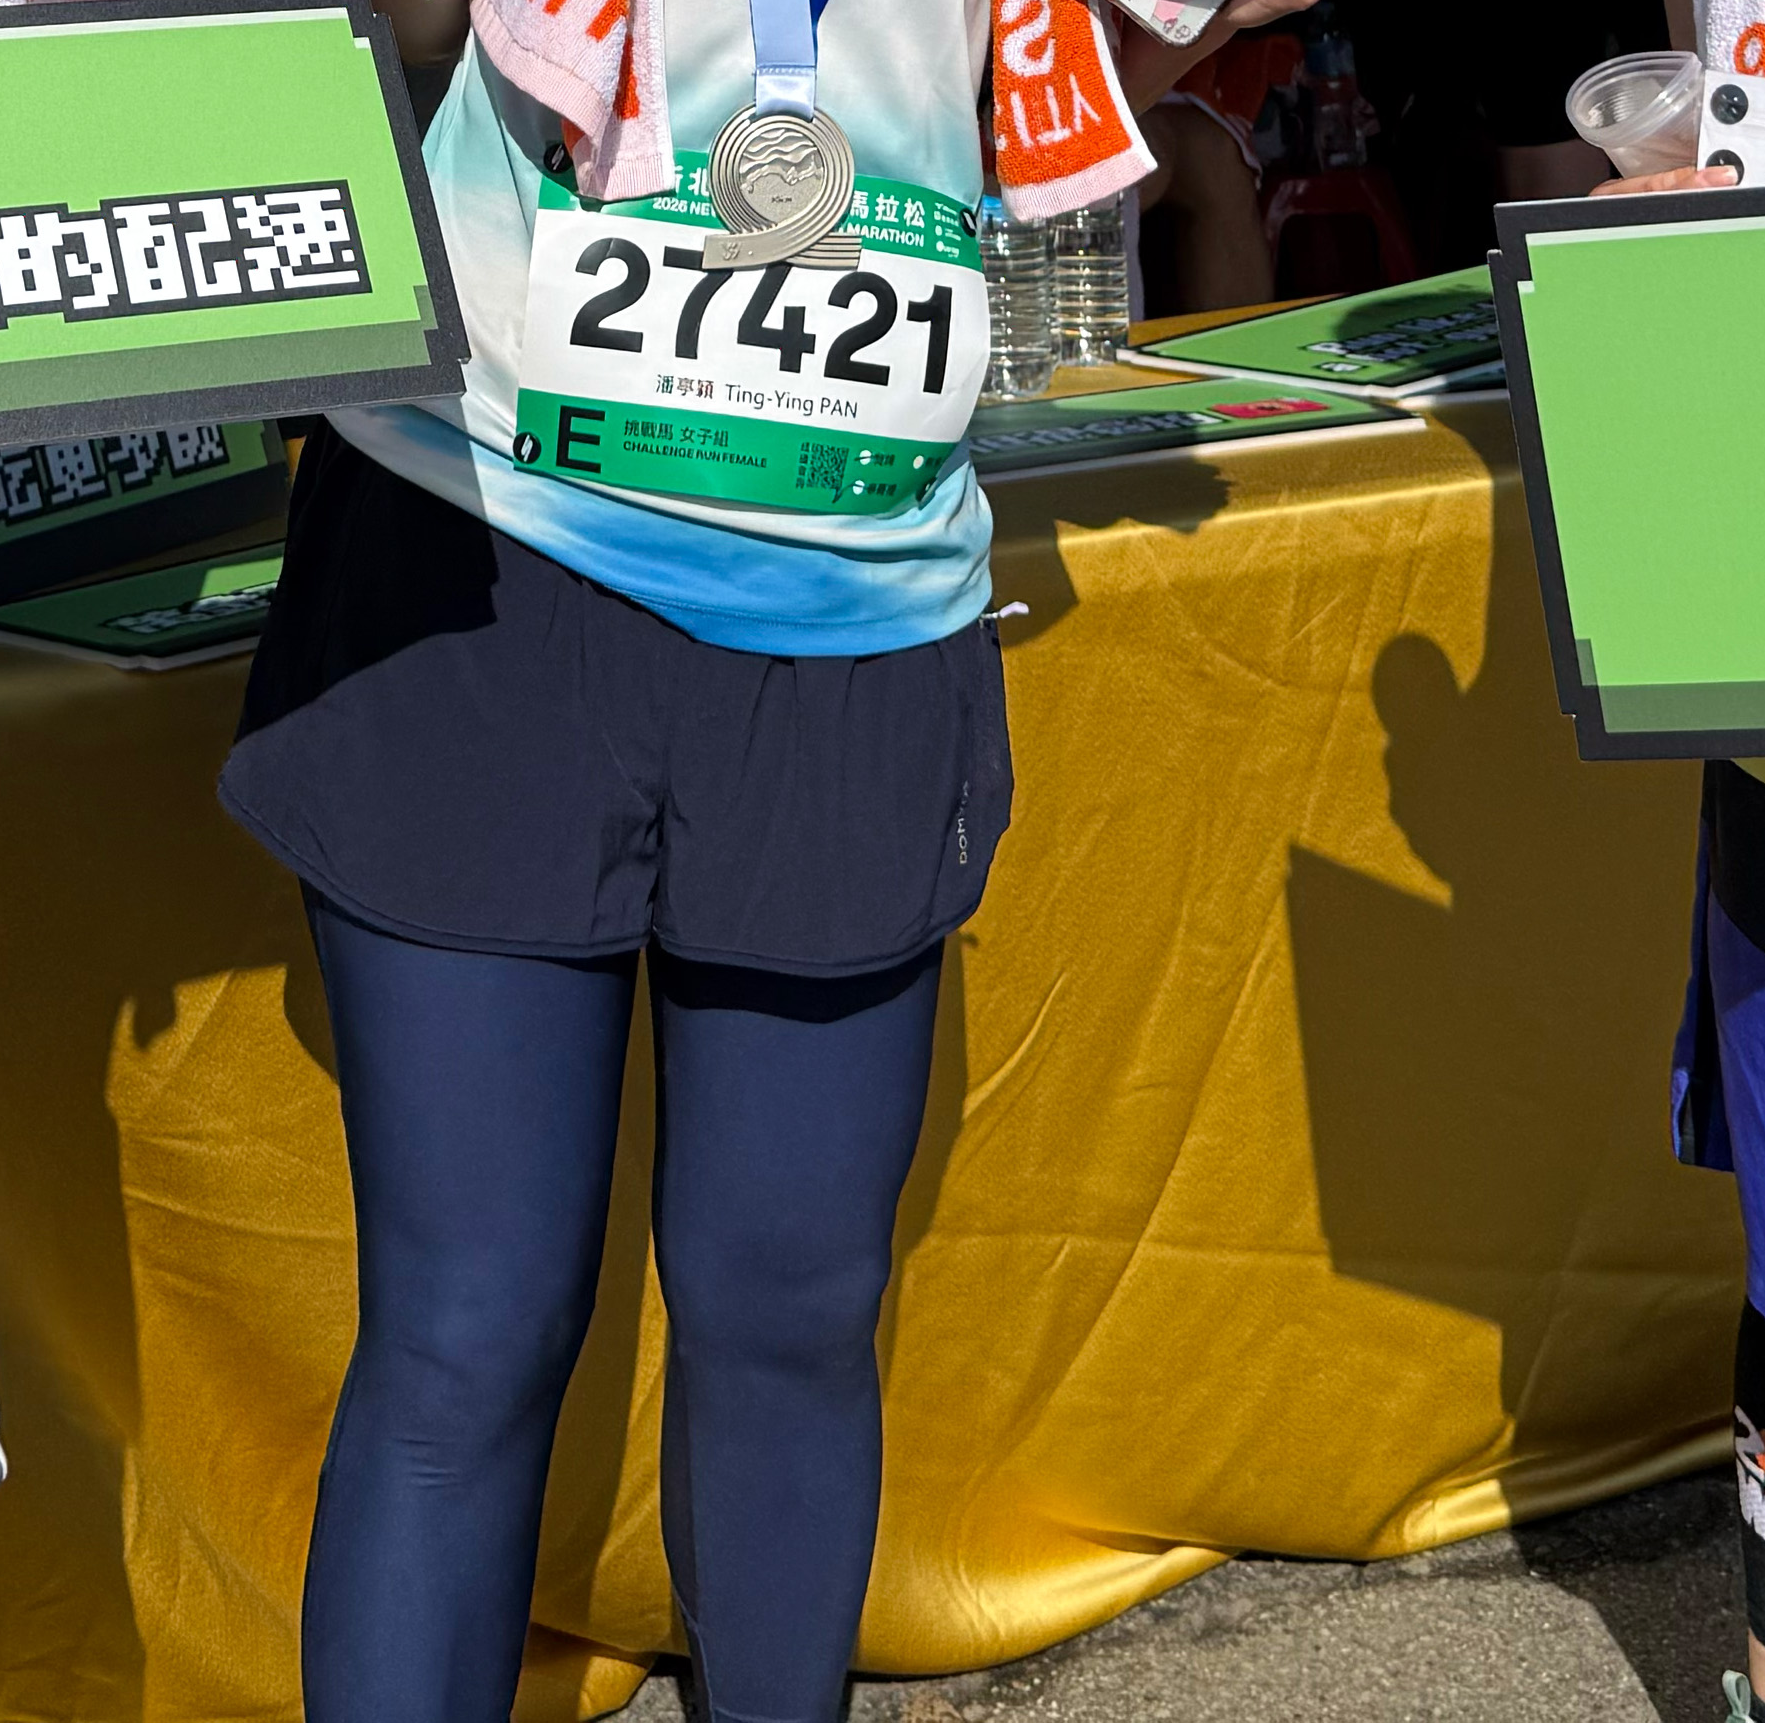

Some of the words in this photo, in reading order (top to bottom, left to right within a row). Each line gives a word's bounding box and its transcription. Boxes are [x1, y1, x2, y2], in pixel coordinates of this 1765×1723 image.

[652, 196, 688, 215] 2026
[845, 222, 925, 248] MARATHON
[569, 236, 954, 395] 27421
[725, 383, 814, 417] Ting-Ying
[819, 396, 859, 419] PAN
[555, 405, 607, 474] E
[622, 440, 694, 460] CHALLENGE
[721, 453, 768, 469] FEMALE
